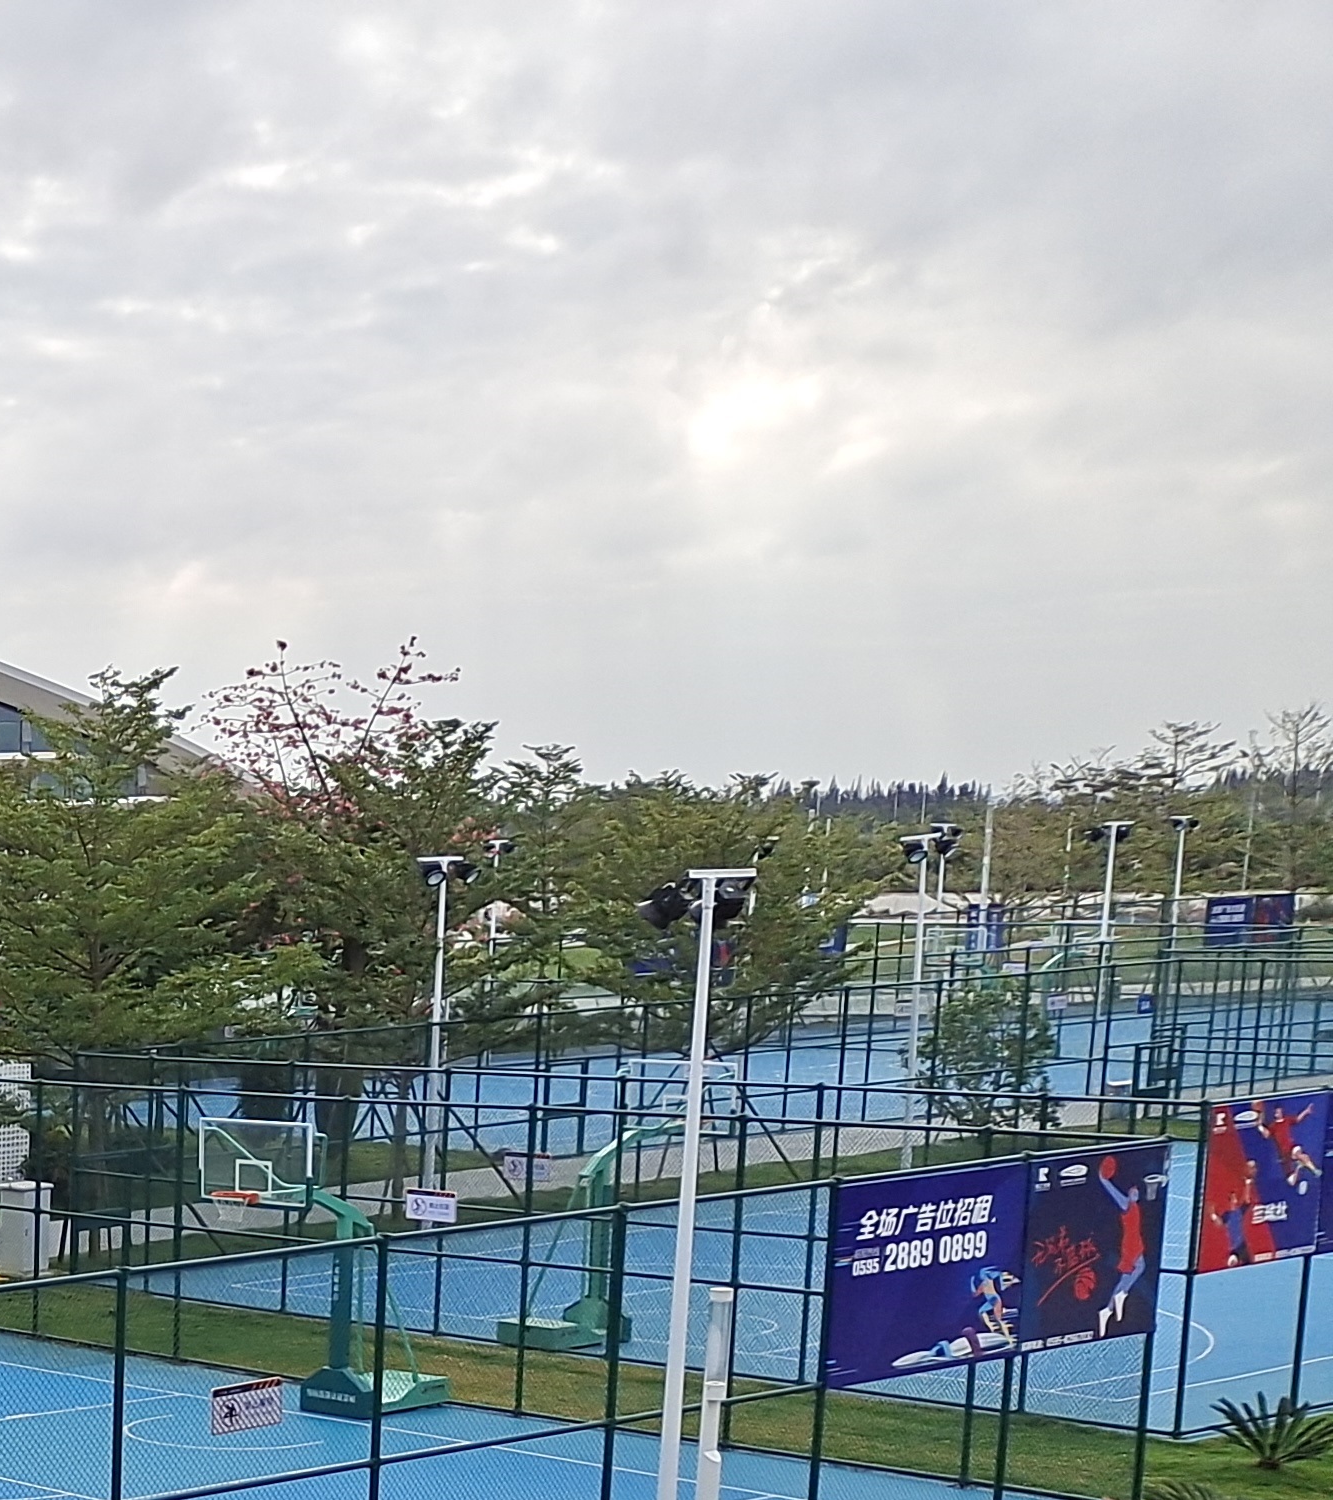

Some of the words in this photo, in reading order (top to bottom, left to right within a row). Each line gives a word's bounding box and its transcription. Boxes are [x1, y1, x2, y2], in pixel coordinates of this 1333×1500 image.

[852, 1257, 880, 1277] 0595
[884, 1238, 934, 1273] 2889
[938, 1230, 988, 1264] 0899
